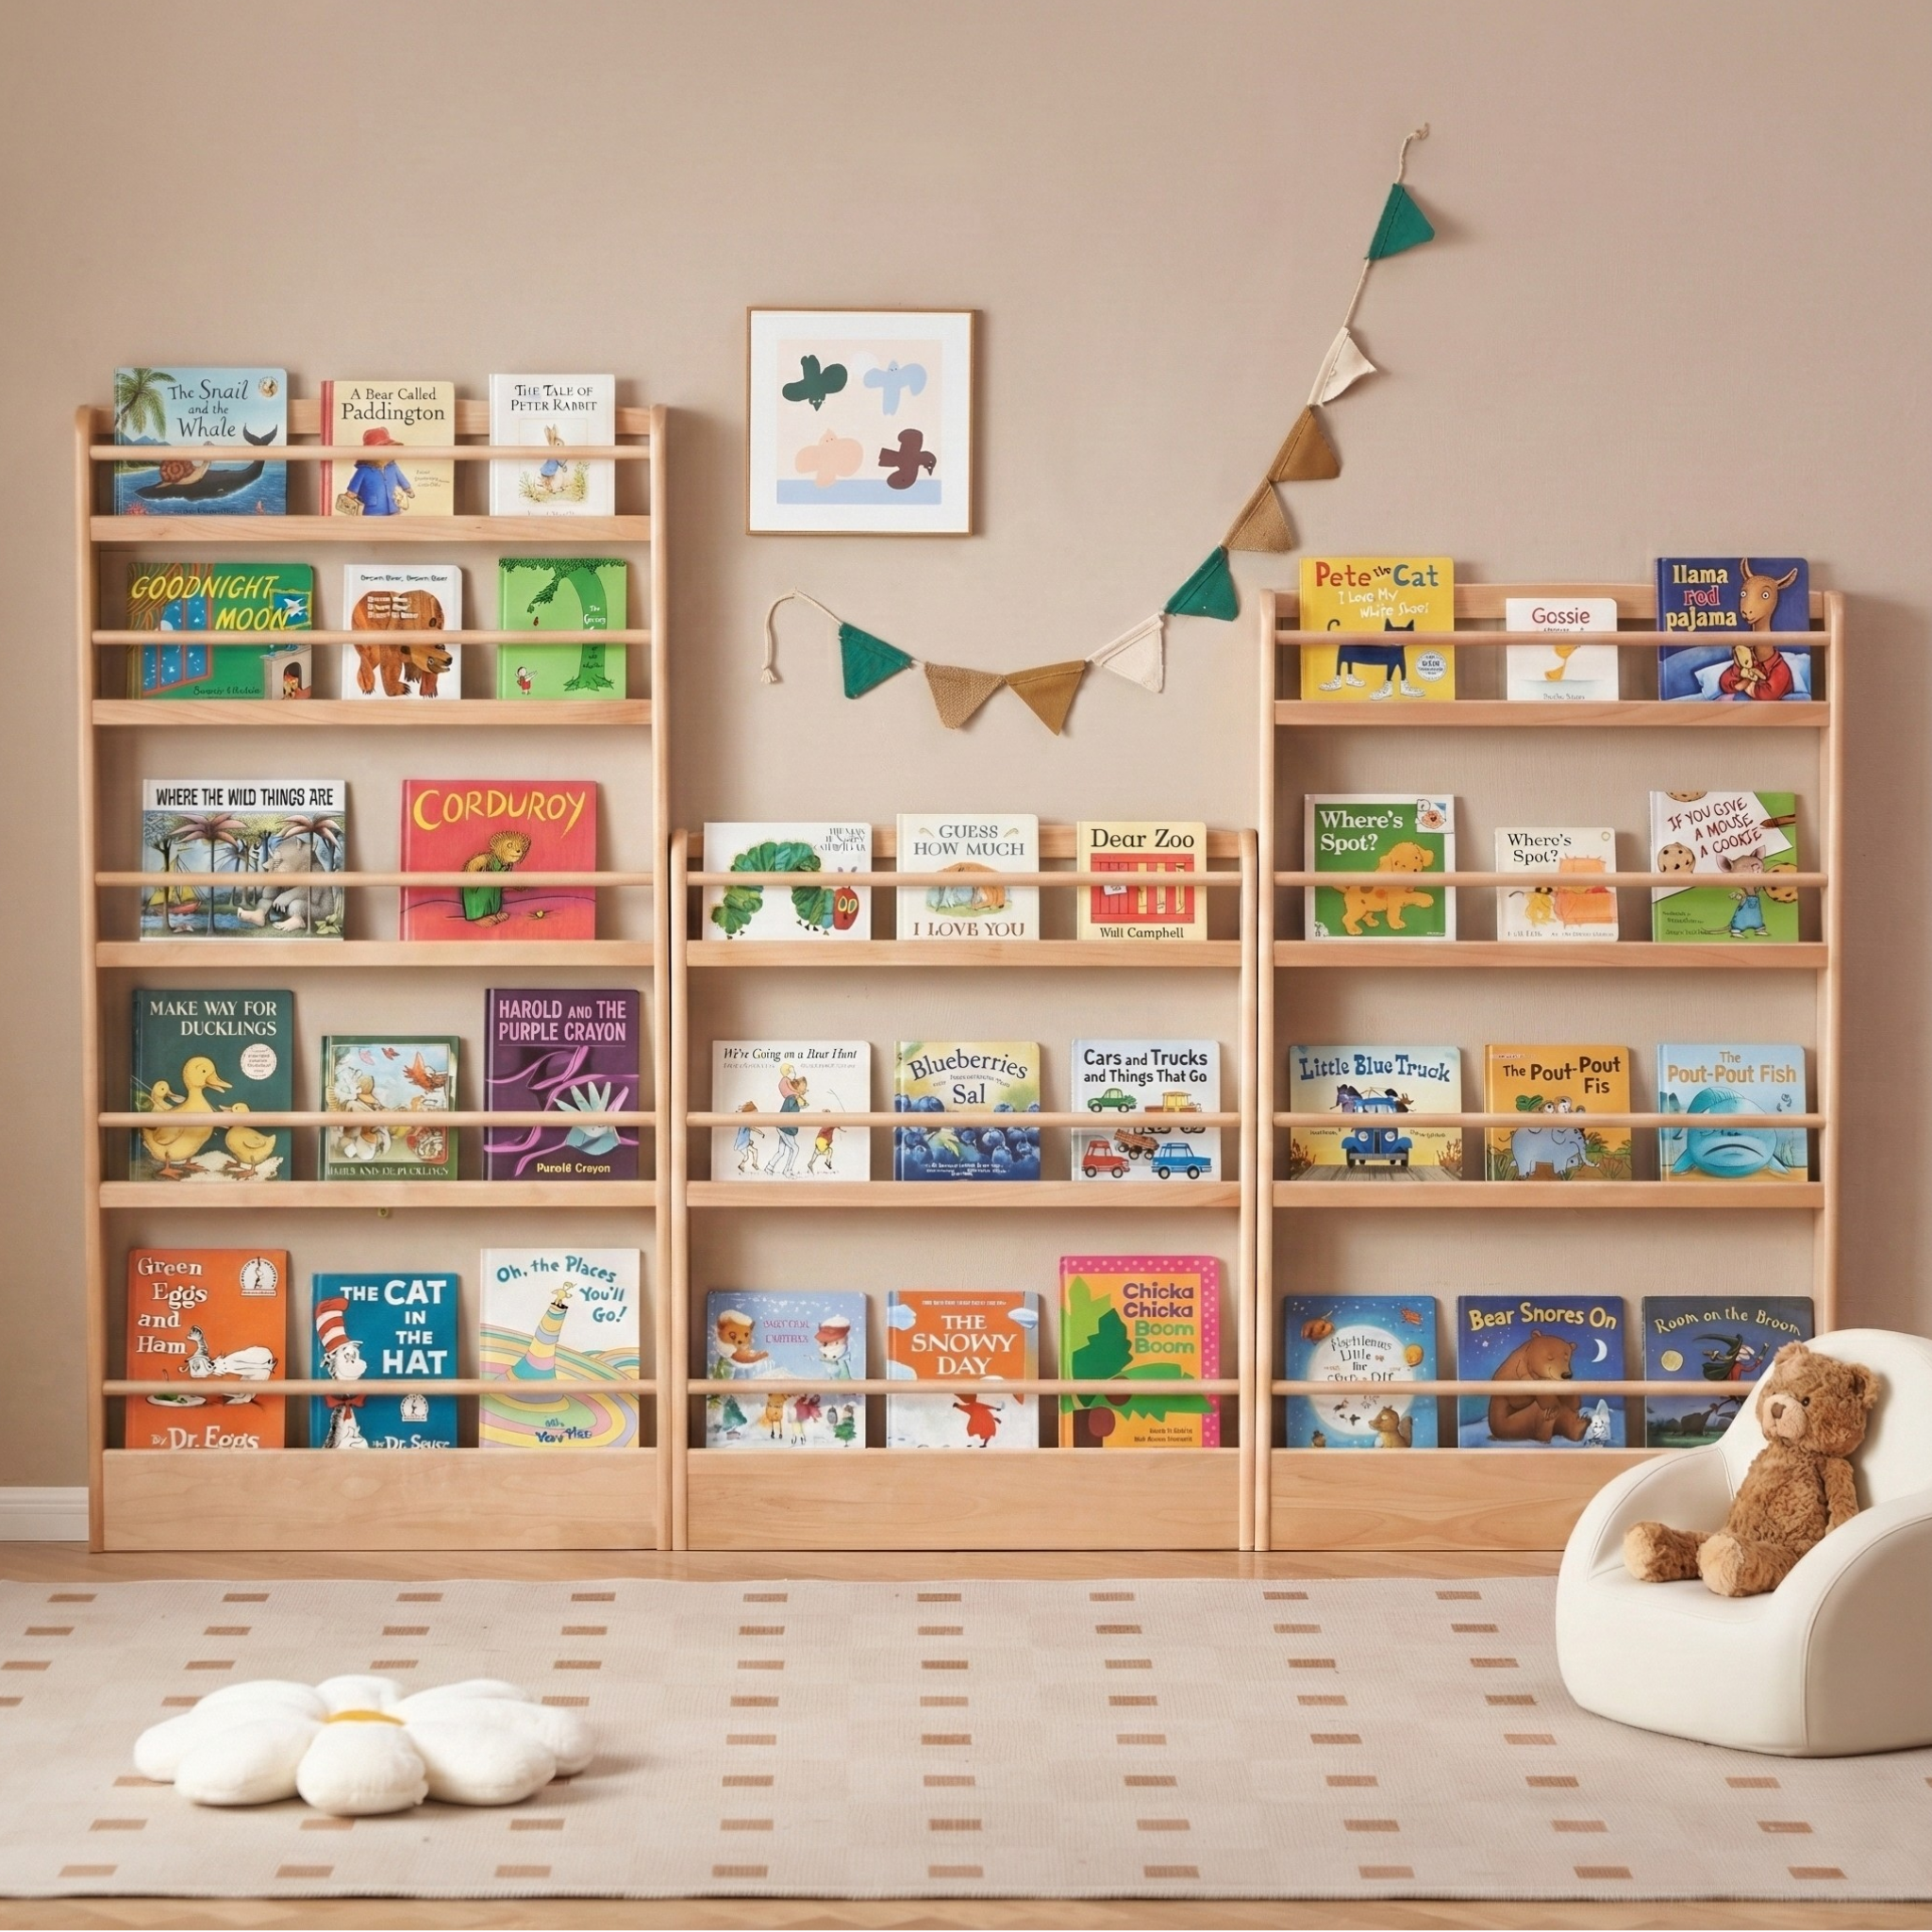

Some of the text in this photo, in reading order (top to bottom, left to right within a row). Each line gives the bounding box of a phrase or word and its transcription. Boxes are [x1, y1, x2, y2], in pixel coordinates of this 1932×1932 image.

[168, 378, 248, 400] The Snail
[350, 388, 437, 400] A Bear Called
[576, 387, 593, 396] OF
[188, 400, 229, 414] and the
[341, 402, 445, 425] Paddington
[176, 416, 236, 438] Whale
[1315, 561, 1372, 587] Pete
[1393, 564, 1439, 587] Cat
[1673, 564, 1728, 584] llama
[130, 575, 279, 600] GOODNIGHT
[1338, 588, 1399, 605] I Love My
[1683, 585, 1720, 606] red
[215, 608, 289, 630] MOON
[1359, 604, 1393, 619] White
[1532, 607, 1591, 624] Gossie
[1665, 607, 1738, 632] pajama
[156, 788, 333, 806] WHERE THE WILD THINGS ARE
[412, 790, 586, 839] CORDUROY
[1319, 809, 1404, 828] Where's
[1667, 797, 1747, 832] IF YOU GIVE
[939, 824, 998, 839] GUESS
[1694, 813, 1754, 841] A MOUSE
[1091, 828, 1194, 848] Dear Zoo
[1321, 833, 1378, 856] Spot?
[1507, 833, 1572, 846] Where's
[1700, 827, 1762, 858] A COOKIE
[913, 841, 1024, 856] HOW MUCH
[1513, 849, 1558, 866] Spot?
[913, 922, 920, 936] I
[985, 922, 1024, 936] YOU
[150, 1001, 277, 1016] MAKE WAY FOR
[499, 1000, 626, 1019] HAROLD AND THE
[180, 1021, 277, 1036] DUCKLINGS
[499, 1023, 626, 1041] PURPLE CRAYON
[752, 1048, 781, 1062] Going
[907, 1048, 1028, 1081] Blueberries
[1084, 1049, 1208, 1066] Cars and Trucks
[1719, 1051, 1741, 1063] The
[1299, 1054, 1451, 1082] Little Blue Truck
[1503, 1056, 1621, 1081] The Pout-Pout
[1667, 1064, 1796, 1083] Pout-Pout Fish
[1084, 1069, 1208, 1087] and Things That Go
[1584, 1077, 1610, 1094] Fis
[953, 1083, 986, 1105] Sal
[138, 1257, 202, 1276] Green
[496, 1255, 617, 1283] Oh, the Places
[152, 1282, 208, 1309] Eggs
[340, 1279, 447, 1306] THE CAT
[579, 1287, 625, 1302] You'll
[1123, 1281, 1194, 1300] Chicka
[138, 1310, 181, 1328] and
[405, 1310, 426, 1324] IN
[592, 1306, 627, 1323] Go!
[1123, 1301, 1193, 1318] Chicka
[1468, 1302, 1617, 1331] Bear Snores On
[941, 1315, 987, 1330] THE
[1134, 1320, 1194, 1336] Boom
[1654, 1306, 1801, 1336] Room on the Broom
[136, 1335, 188, 1355] Ham
[395, 1330, 433, 1344] THE
[911, 1333, 1018, 1353] SNOWY
[1134, 1338, 1194, 1355] Boom
[382, 1349, 448, 1374] HAT
[937, 1356, 992, 1375] DAY
[167, 1427, 200, 1448] Dr.
